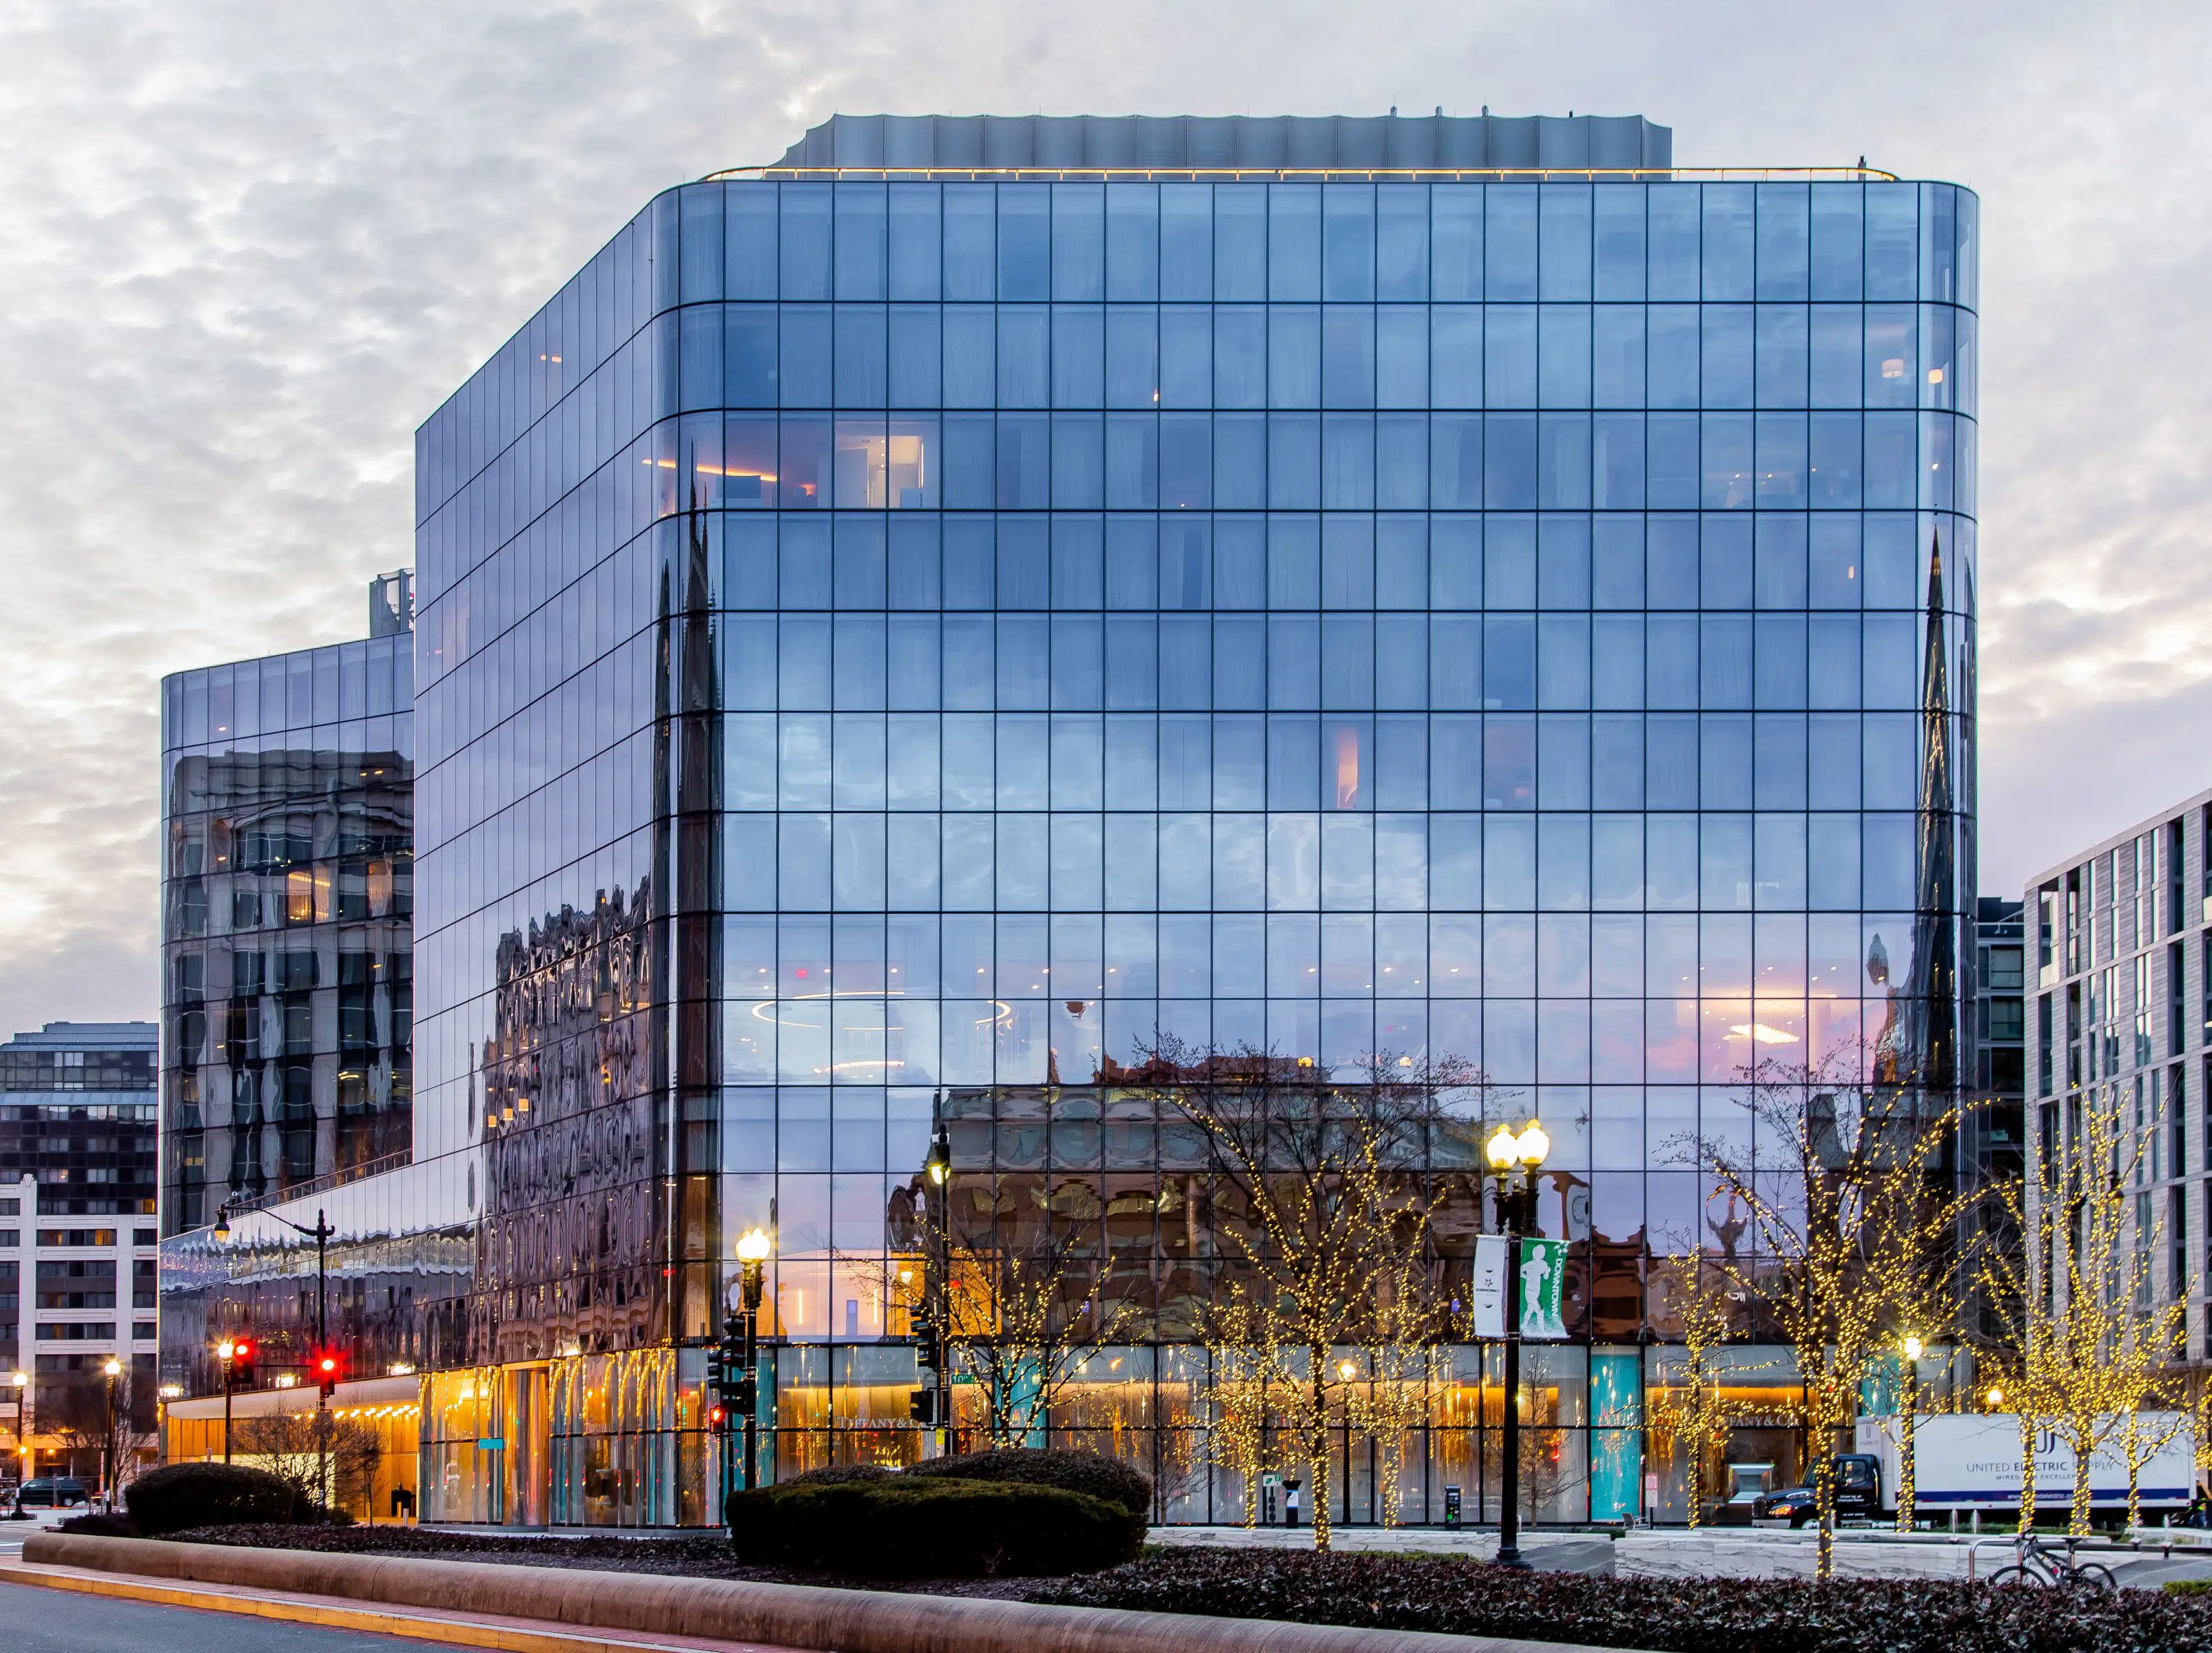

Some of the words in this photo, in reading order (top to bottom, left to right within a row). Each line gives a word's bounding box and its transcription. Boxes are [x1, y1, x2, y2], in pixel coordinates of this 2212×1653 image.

[1551, 1258, 1563, 1317] DOWNTOWN
[837, 1417, 896, 1428] TIFFANY
[1966, 1463, 2010, 1472] UNITED
[2014, 1462, 2067, 1471] ELCTRIC
[2072, 1462, 2114, 1471] SPPLY
